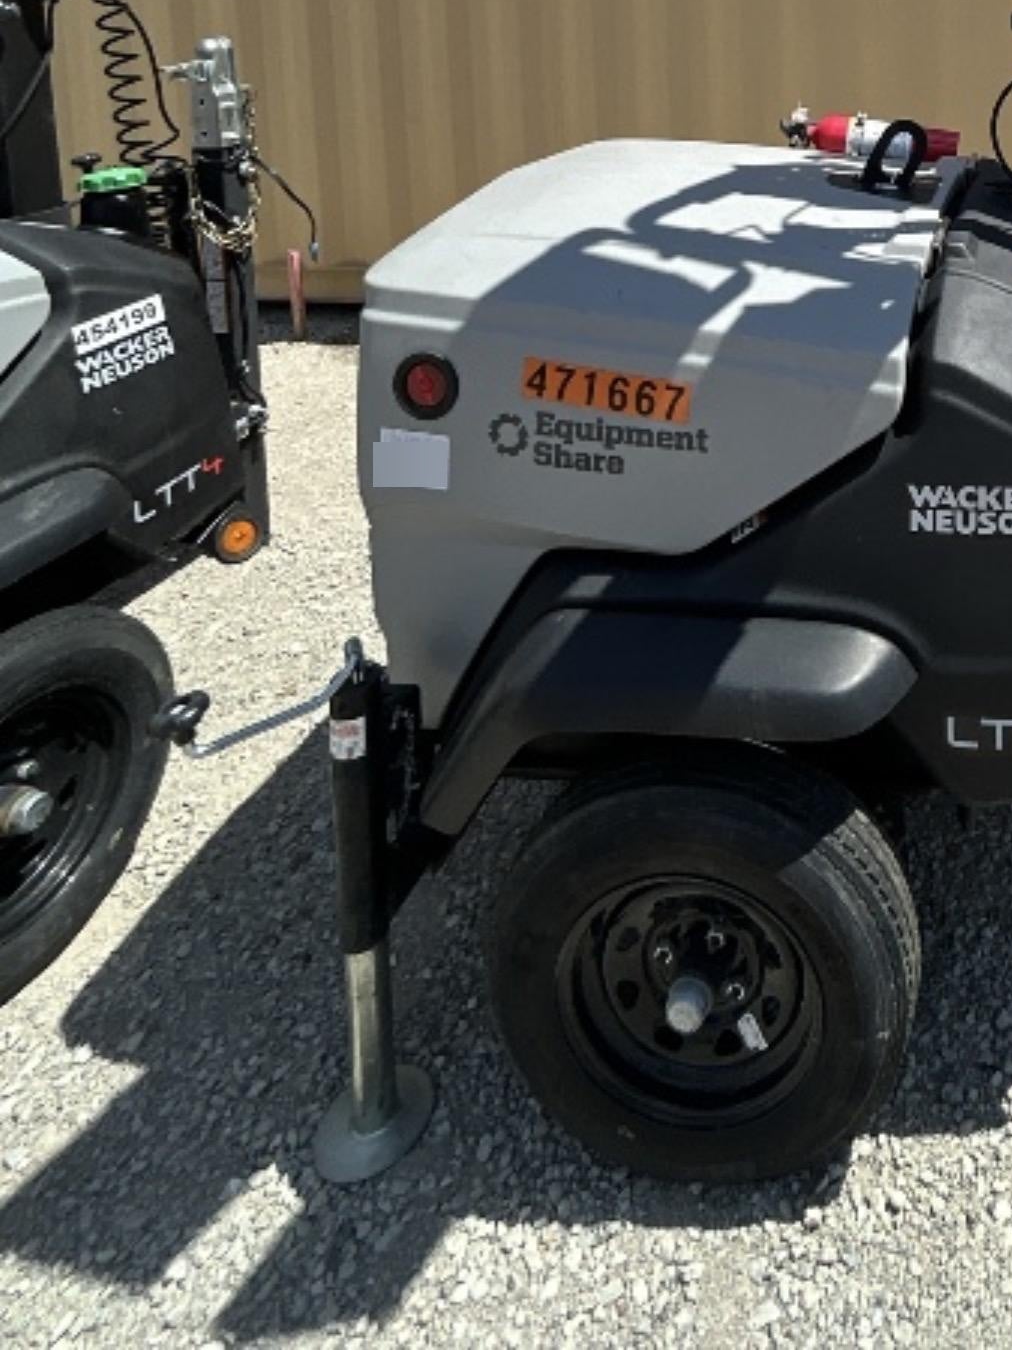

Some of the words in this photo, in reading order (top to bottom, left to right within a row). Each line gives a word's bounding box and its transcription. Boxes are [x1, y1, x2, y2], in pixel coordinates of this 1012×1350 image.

[75, 326, 172, 374] WACKER
[80, 337, 175, 394] NEUSON
[525, 361, 686, 421] 471667
[534, 410, 708, 453] Equipment
[533, 442, 625, 475] Share
